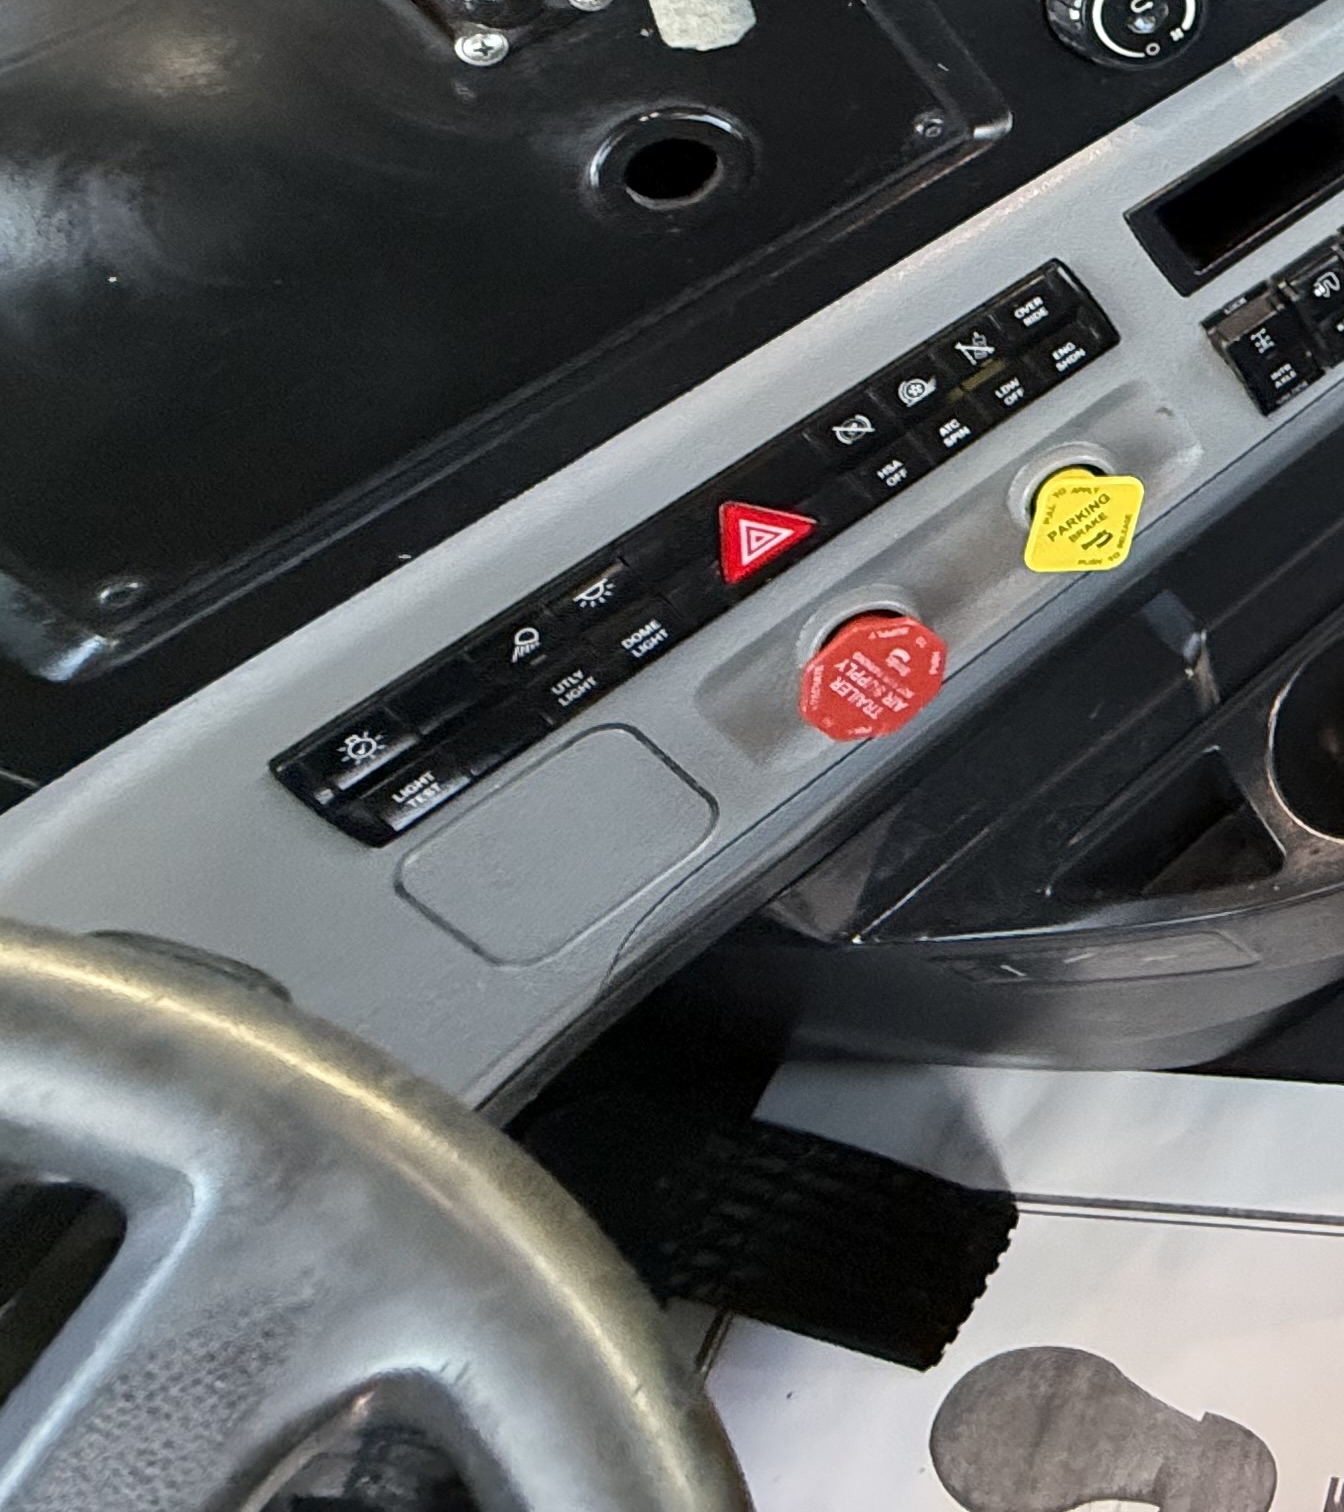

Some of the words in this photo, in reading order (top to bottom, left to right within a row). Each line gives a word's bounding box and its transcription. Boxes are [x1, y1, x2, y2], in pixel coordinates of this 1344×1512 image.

[1014, 296, 1044, 319] OVER
[1022, 306, 1049, 327] RIDE
[1052, 341, 1076, 361] ENG
[1055, 348, 1086, 372] SHDN
[994, 377, 1021, 399] LDW
[1003, 386, 1024, 406] OFF
[939, 418, 961, 437] ATC
[943, 426, 971, 448] SPIN
[876, 460, 904, 480] HSA
[886, 467, 908, 487] OFF
[1053, 487, 1067, 499] TO
[1047, 493, 1111, 542] PARKING
[1068, 512, 1108, 543] BRAKE
[1108, 551, 1121, 562] TO
[621, 618, 661, 649] DOME
[631, 628, 669, 658] LIGHT
[551, 669, 584, 695] UTLY
[834, 659, 886, 698] SUPPLY
[558, 676, 597, 707] LIGHT
[829, 676, 884, 720] TRAILER
[881, 691, 910, 713] AIR
[391, 771, 436, 804] LIGHT
[405, 782, 441, 808] TEST
